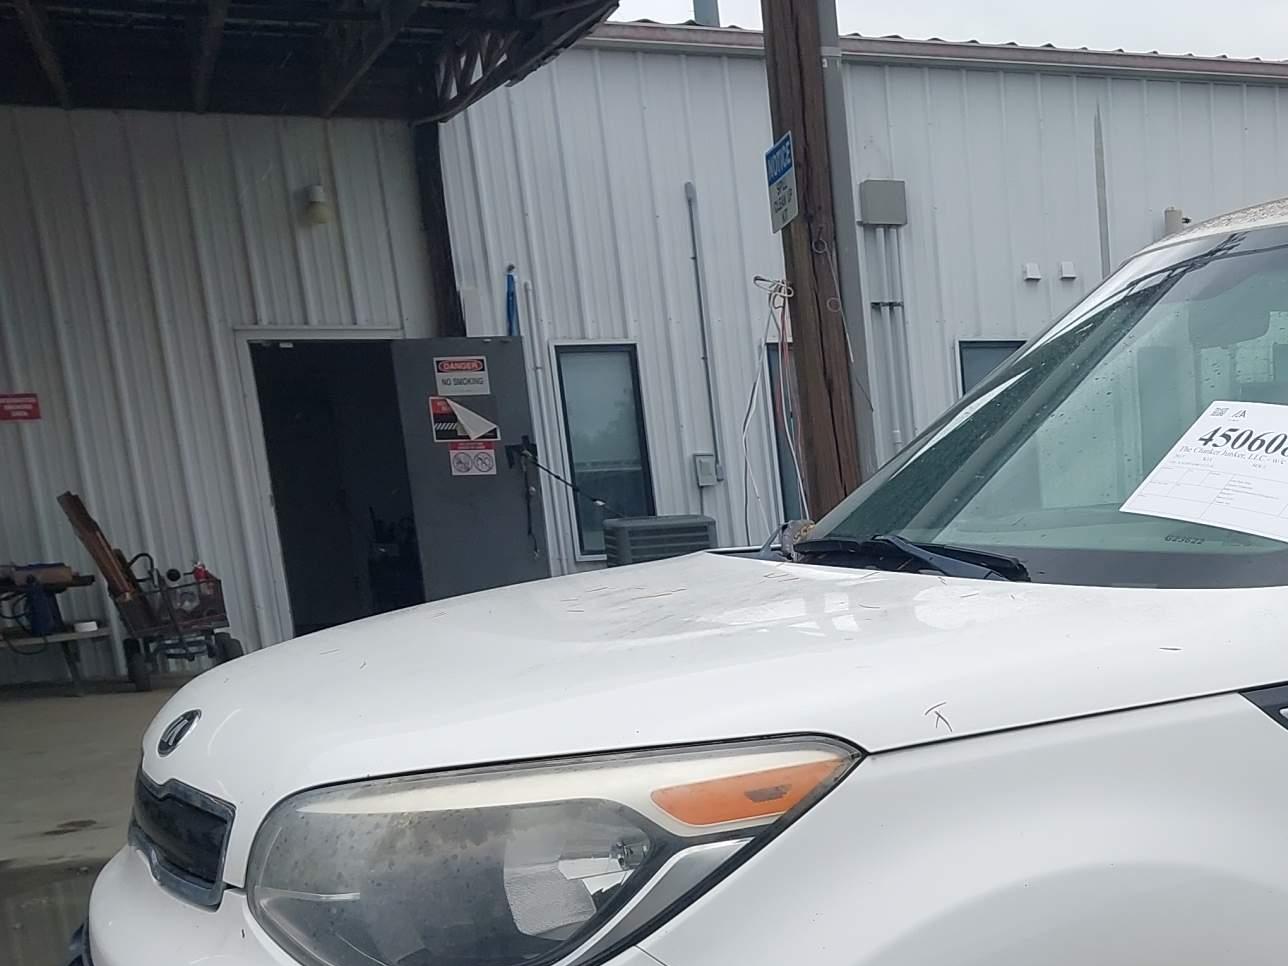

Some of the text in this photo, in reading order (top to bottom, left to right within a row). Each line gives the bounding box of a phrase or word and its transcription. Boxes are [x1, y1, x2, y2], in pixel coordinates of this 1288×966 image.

[767, 140, 792, 179] NOTICE
[442, 361, 479, 370] DANGER
[441, 377, 484, 386] NO SMOKING
